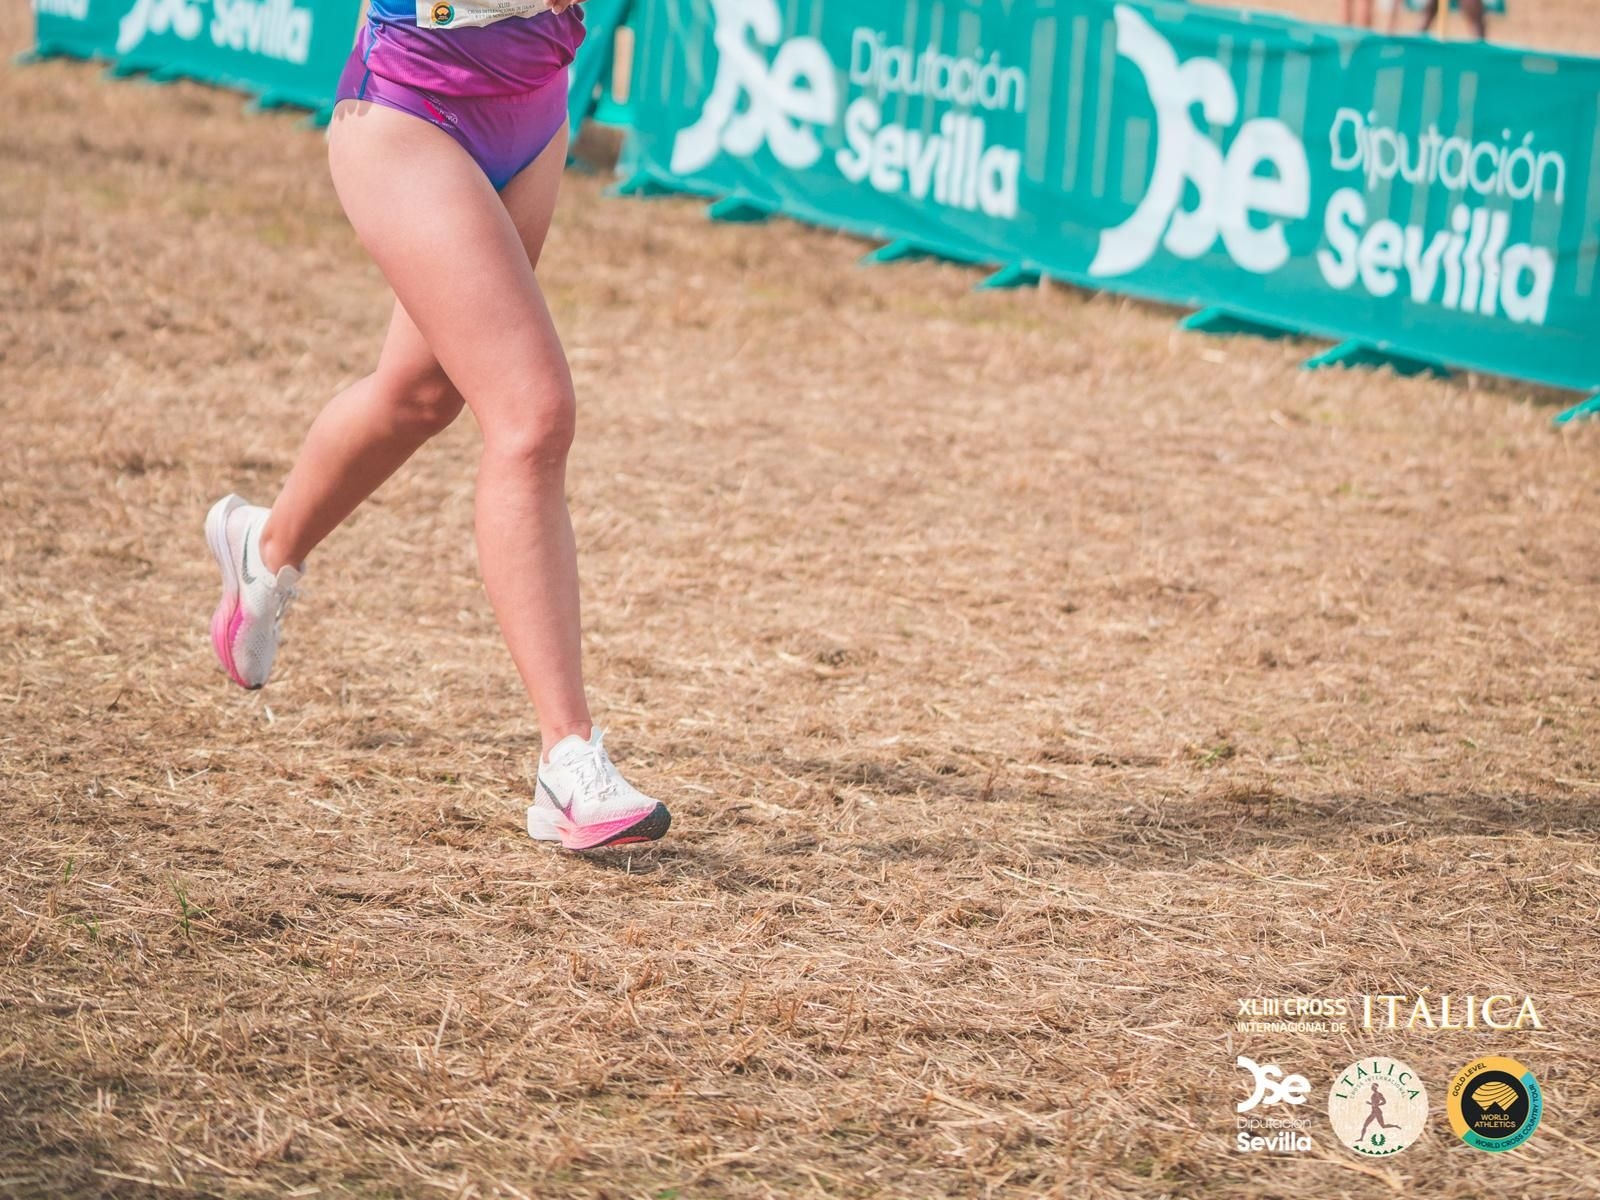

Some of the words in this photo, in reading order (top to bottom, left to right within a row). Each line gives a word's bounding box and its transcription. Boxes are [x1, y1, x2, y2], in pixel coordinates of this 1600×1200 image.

[849, 26, 1026, 113] Diputación
[834, 96, 1021, 219] Sevilla
[1329, 106, 1566, 204] Diputación
[1316, 187, 1555, 326] Sevilla
